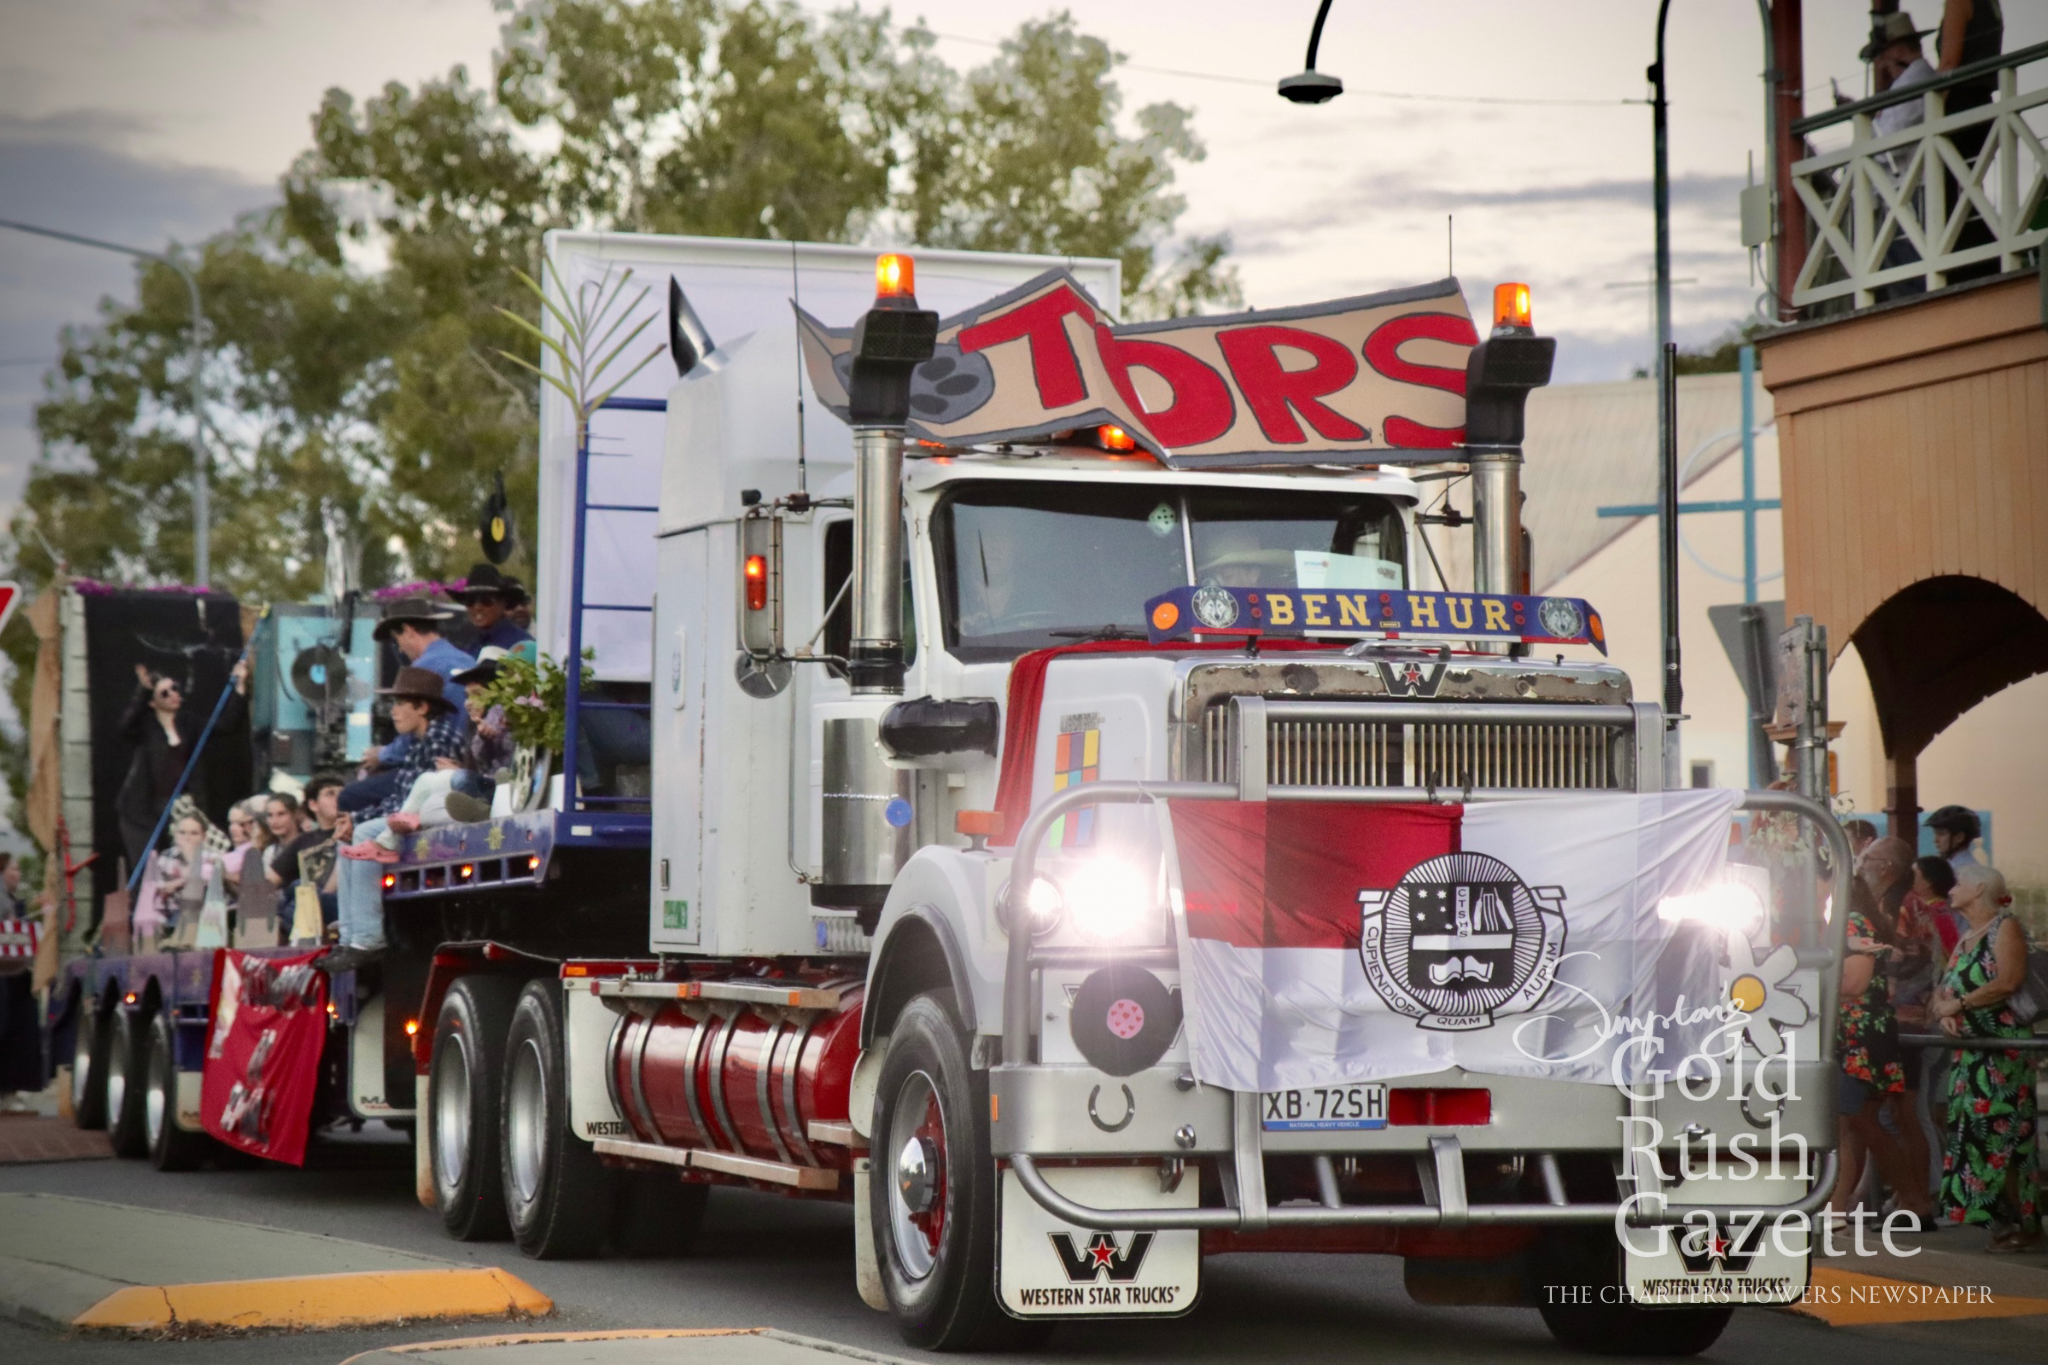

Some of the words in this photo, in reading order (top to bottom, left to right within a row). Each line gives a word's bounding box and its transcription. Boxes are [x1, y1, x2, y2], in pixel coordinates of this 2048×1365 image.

[1269, 594, 1371, 626] BEN
[1408, 595, 1511, 631] HUR
[1436, 1015, 1481, 1026] QUAM
[586, 1121, 626, 1135] WESTE
[1021, 1288, 1084, 1306] WESTERN
[1089, 1287, 1121, 1305] STAR
